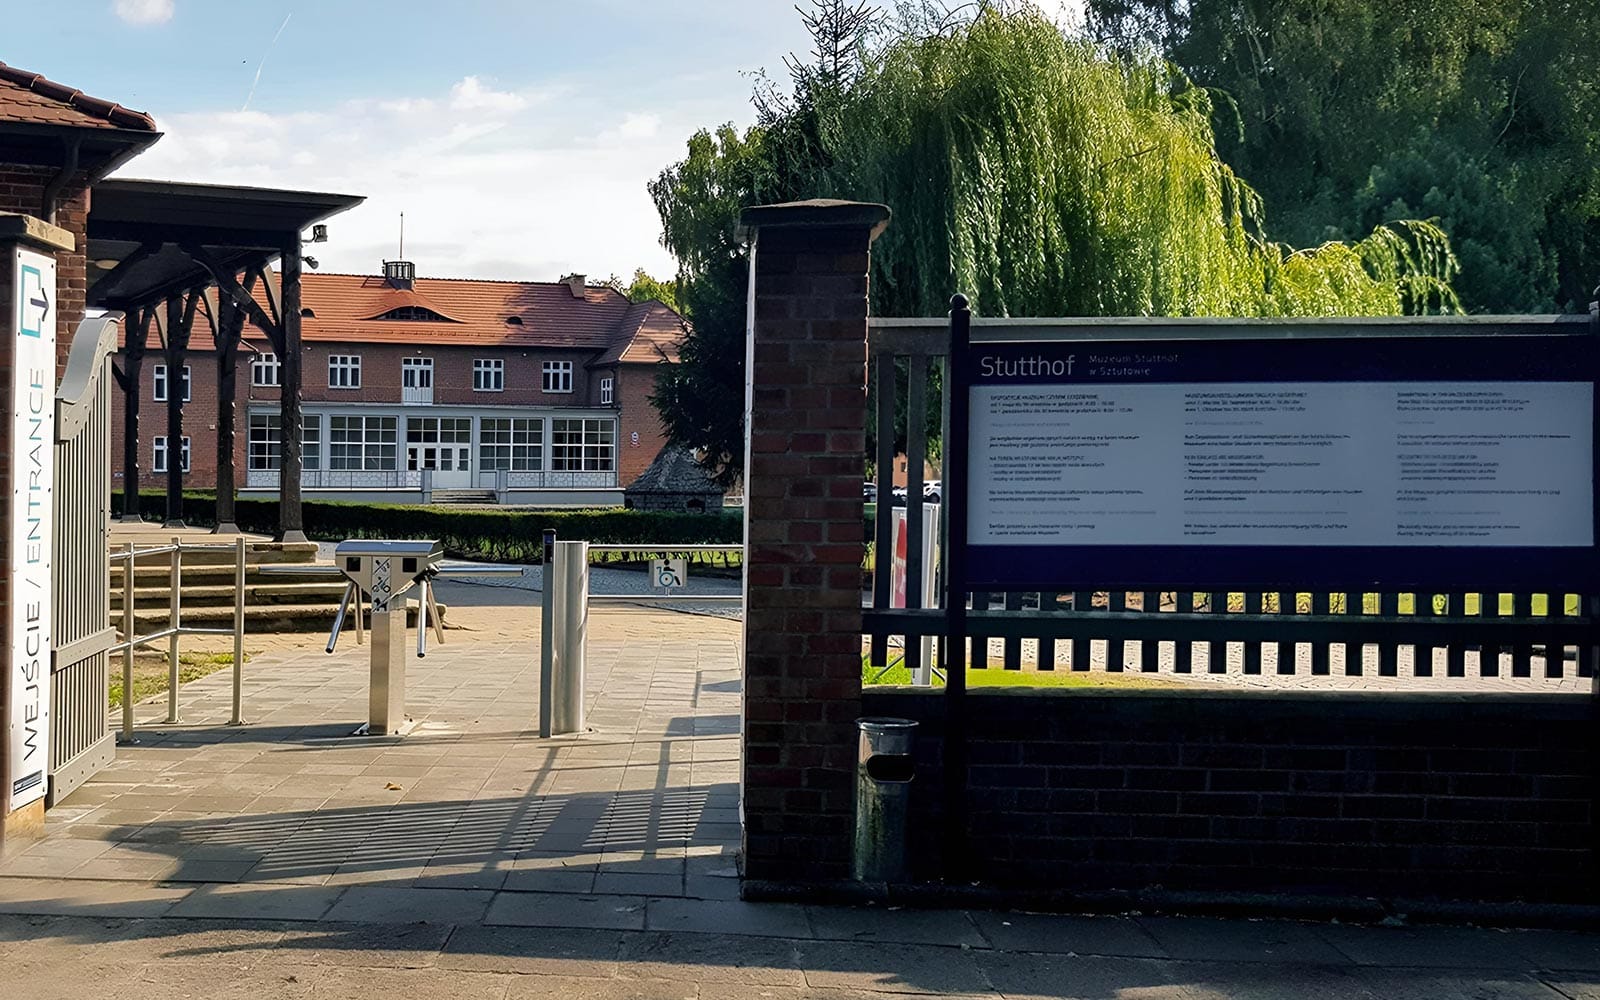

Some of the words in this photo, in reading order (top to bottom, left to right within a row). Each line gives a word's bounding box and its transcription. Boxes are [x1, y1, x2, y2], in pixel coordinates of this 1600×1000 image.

[980, 354, 1076, 377] Stutthof
[27, 368, 45, 565] ENTRANCE
[22, 600, 41, 761] WEJŚCIE
